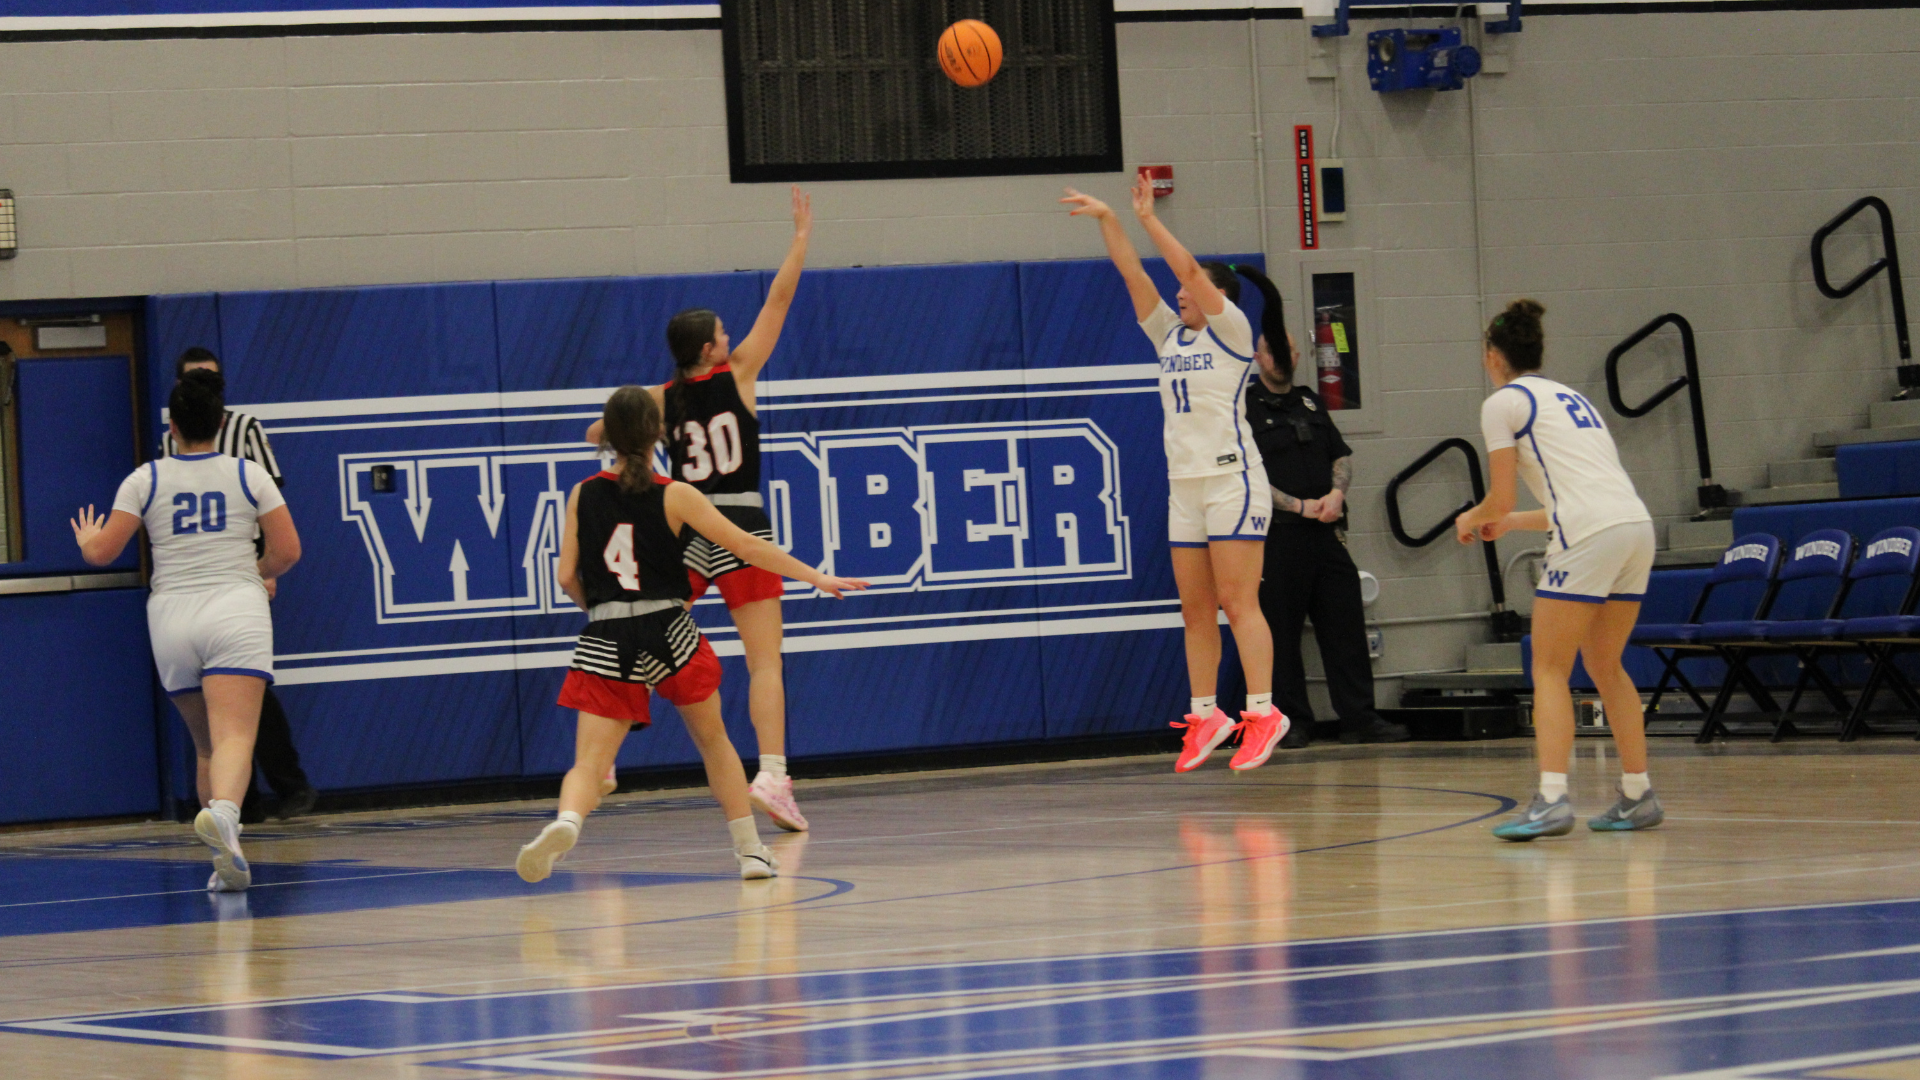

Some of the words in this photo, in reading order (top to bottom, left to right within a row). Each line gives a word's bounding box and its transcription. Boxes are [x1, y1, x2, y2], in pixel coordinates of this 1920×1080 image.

[1300, 131, 1308, 158] FIRE
[1301, 165, 1313, 246] EXTINGUISHER
[1160, 353, 1214, 374] NDBER
[1171, 378, 1192, 413] 11
[1555, 393, 1602, 429] 21
[674, 411, 743, 482] 30
[172, 491, 227, 535] 20
[338, 418, 1133, 625] WDBER
[1251, 516, 1267, 531] W
[603, 523, 641, 591] 4
[1548, 570, 1569, 588] W
